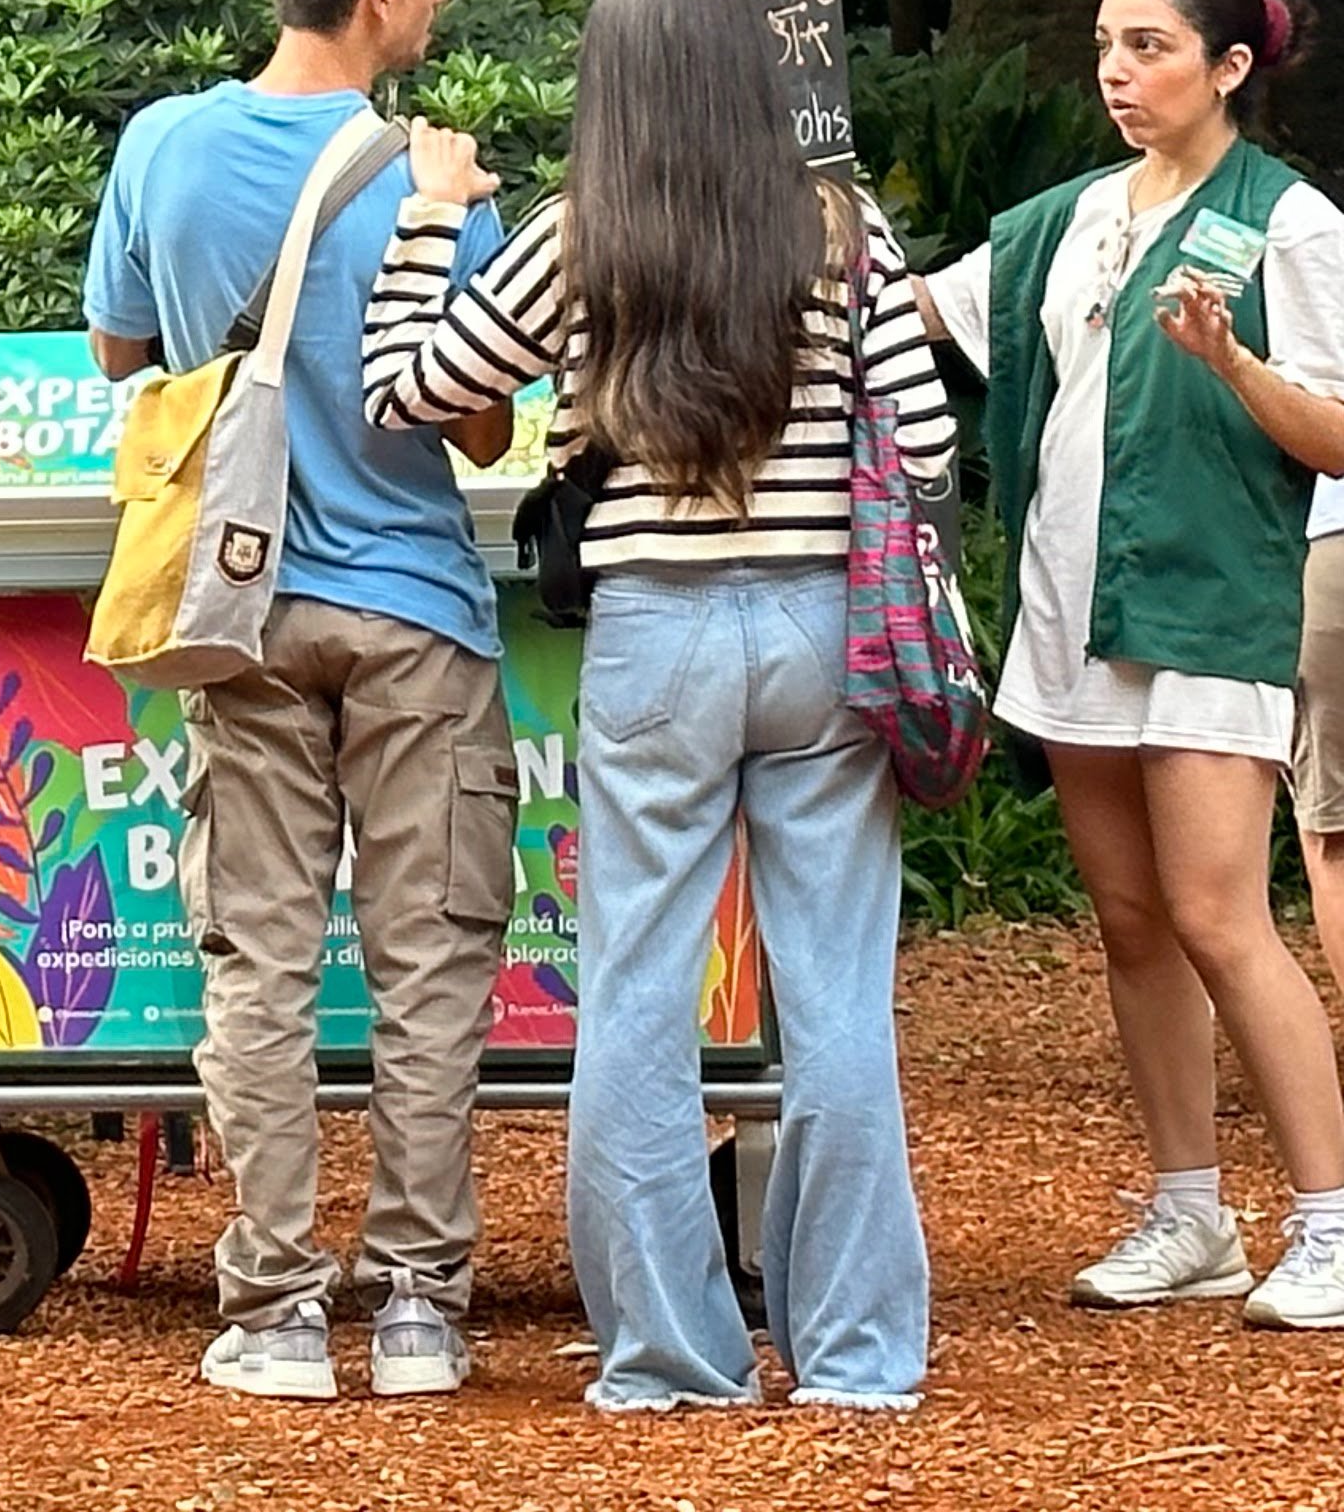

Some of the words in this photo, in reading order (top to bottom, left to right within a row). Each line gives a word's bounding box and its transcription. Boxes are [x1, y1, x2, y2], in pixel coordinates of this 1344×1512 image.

[131, 921, 148, 938] a
[153, 921, 193, 945] pru
[36, 947, 195, 974] expediciones
